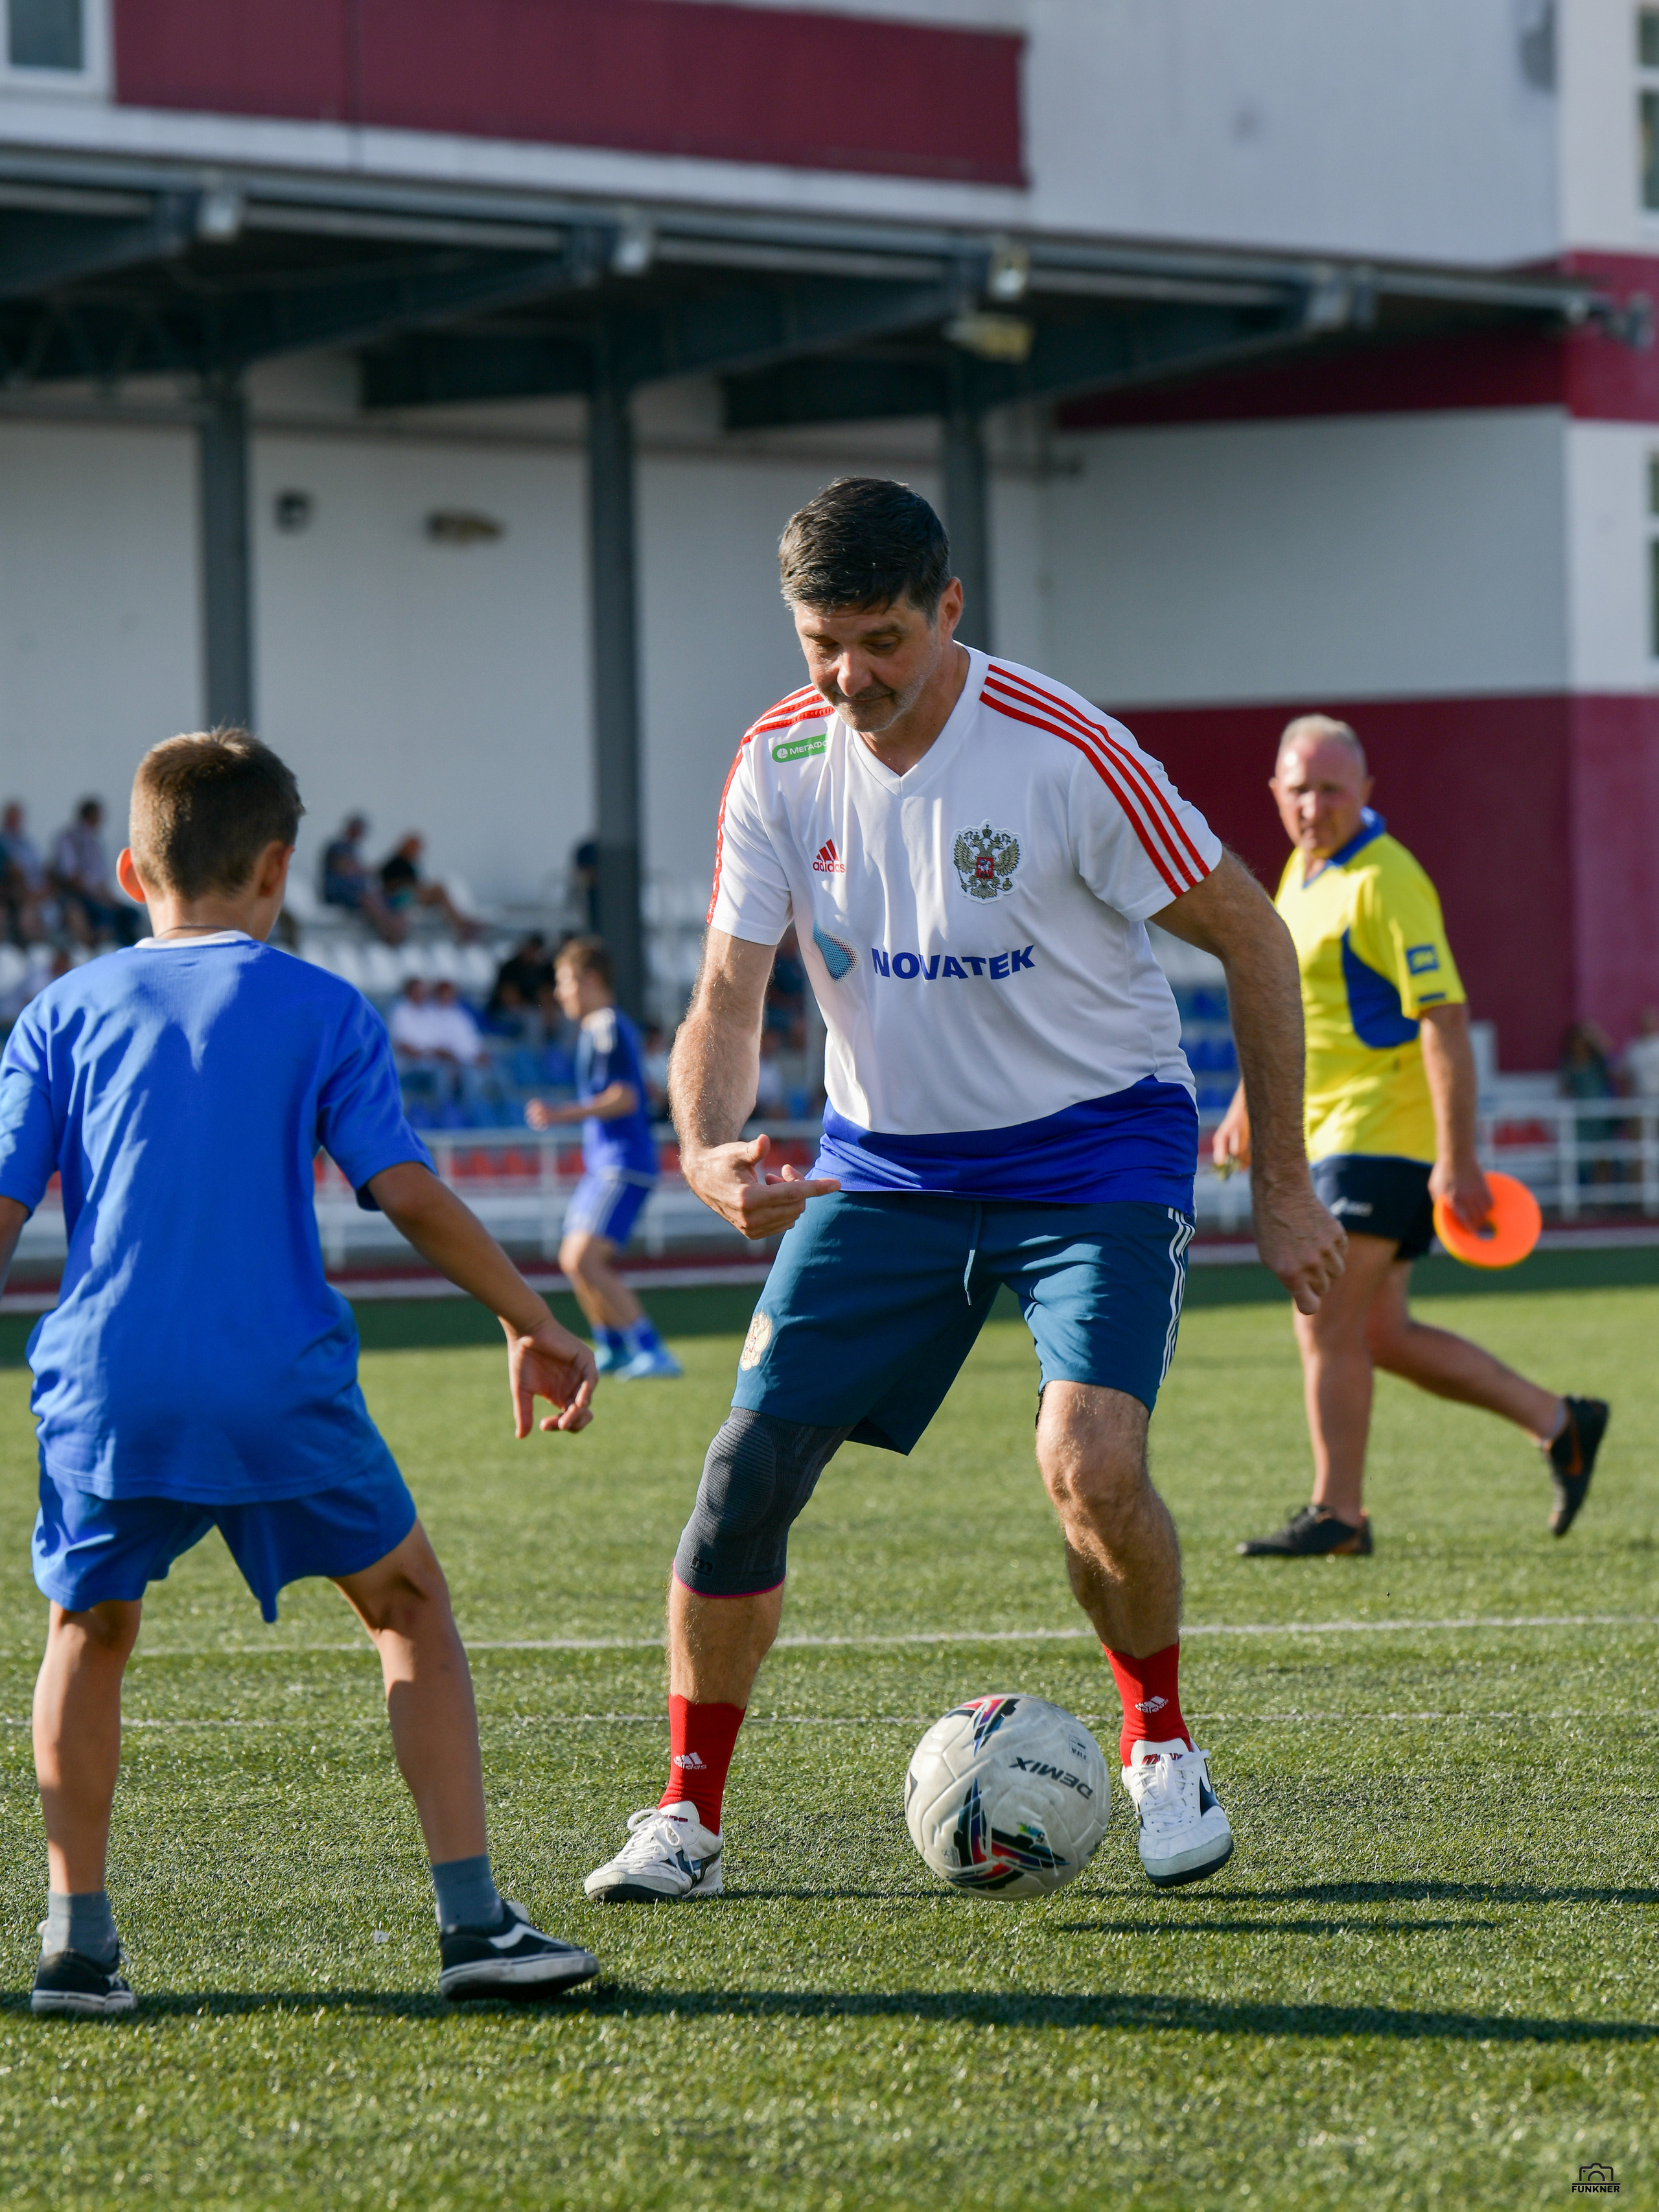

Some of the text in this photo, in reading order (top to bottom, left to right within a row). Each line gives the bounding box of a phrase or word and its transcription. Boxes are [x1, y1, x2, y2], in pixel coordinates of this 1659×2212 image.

[812, 860, 846, 873] adidas
[871, 944, 1036, 980] NOVATEK
[1008, 1756, 1093, 1800] DEMIX
